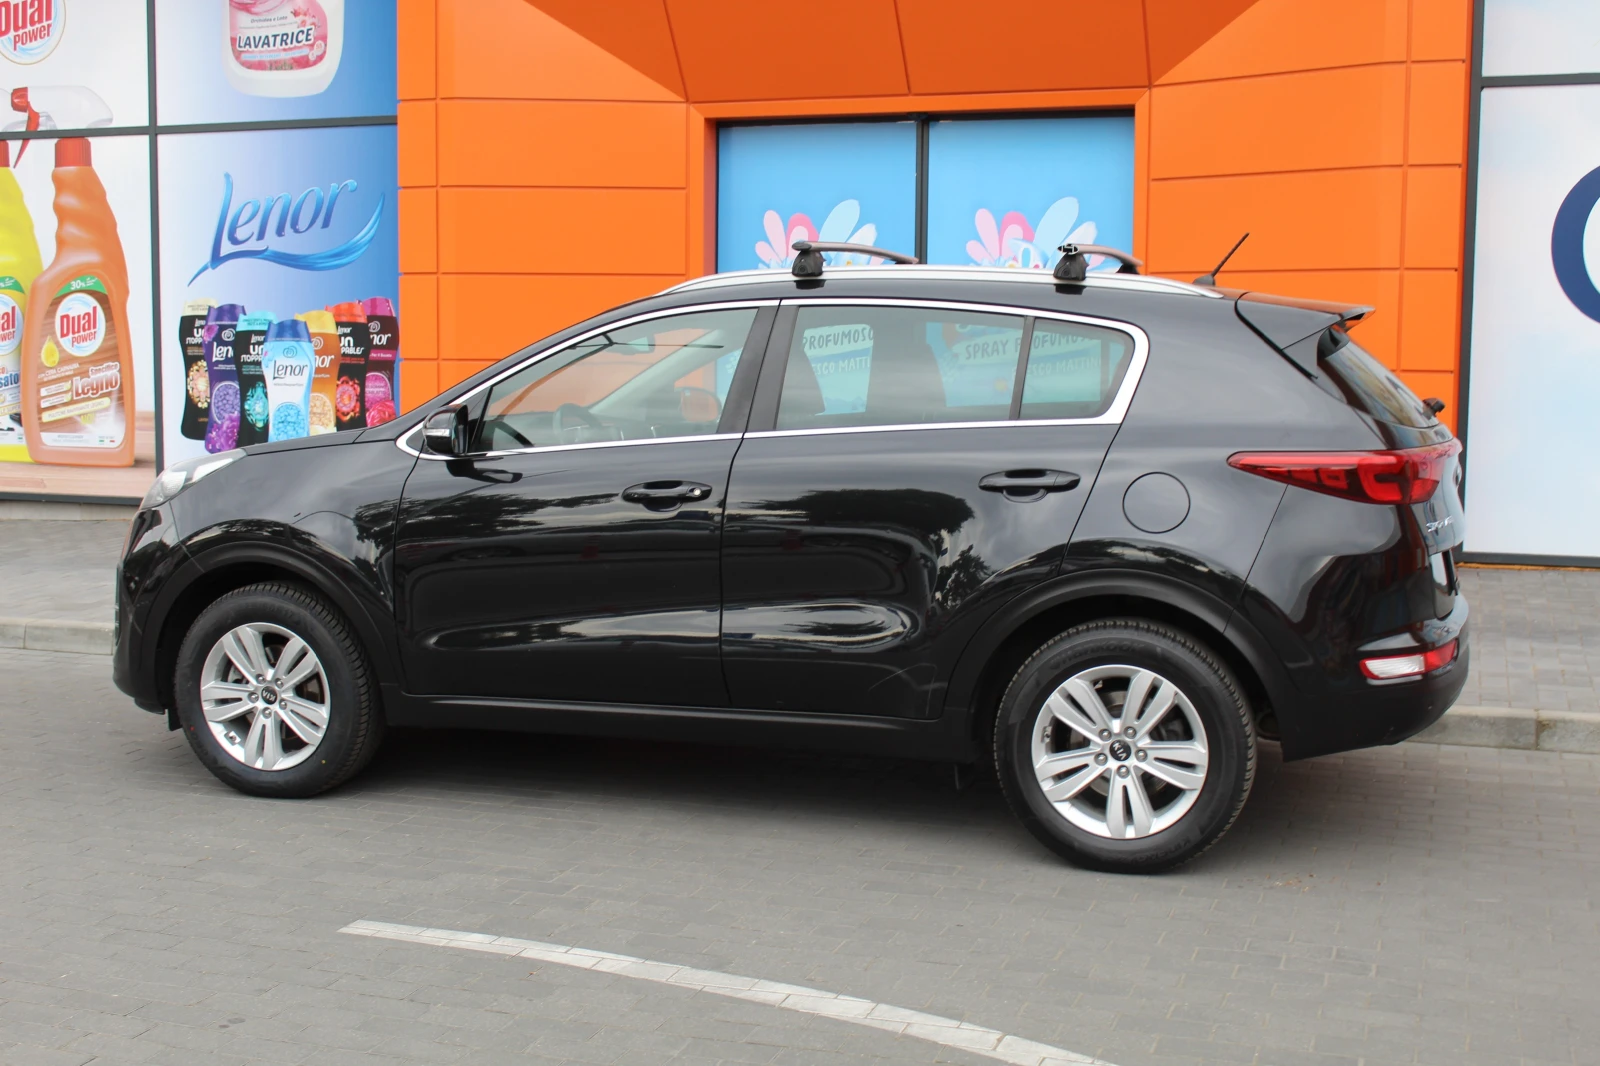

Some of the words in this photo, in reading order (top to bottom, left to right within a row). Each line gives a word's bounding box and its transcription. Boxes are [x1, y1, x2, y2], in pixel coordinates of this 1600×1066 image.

[237, 27, 313, 49] LAVATRICE
[210, 171, 358, 270] Lenor
[60, 305, 97, 339] Dual
[370, 333, 392, 346] nor
[965, 339, 1009, 360] SPRAY
[212, 341, 234, 363] Len
[273, 360, 308, 381] Lenor
[839, 356, 870, 373] MATTI
[73, 371, 119, 399] Legno
[1112, 740, 1128, 761] KIA
